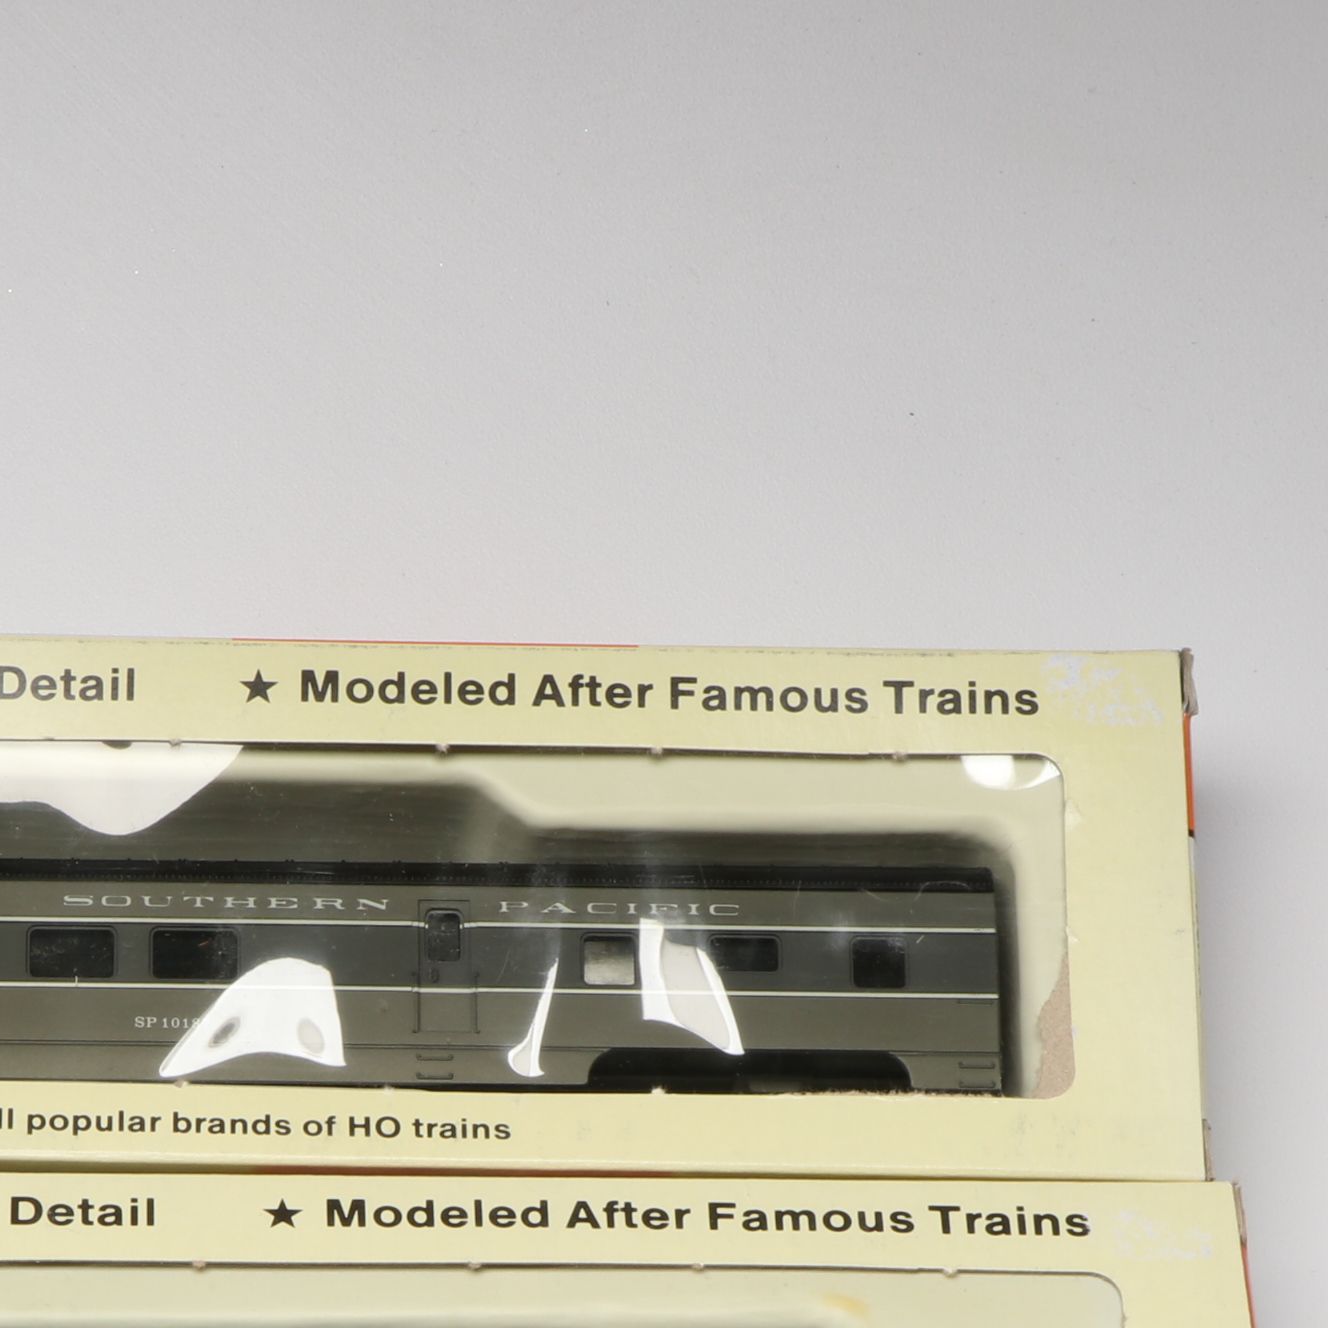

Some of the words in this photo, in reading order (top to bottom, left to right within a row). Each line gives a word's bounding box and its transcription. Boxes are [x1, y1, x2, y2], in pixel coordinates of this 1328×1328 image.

[299, 668, 517, 709] Modeled
[532, 673, 654, 711] After
[670, 676, 870, 715] Famous
[884, 680, 1041, 717] Trains
[62, 894, 390, 912] SOUTHERN
[498, 900, 742, 918] PACIFIC
[134, 1015, 157, 1028] SP
[26, 1106, 161, 1137] popular
[171, 1109, 292, 1137] brands
[301, 1112, 337, 1138] of
[348, 1114, 401, 1139] HO
[411, 1114, 512, 1142] trains
[9, 1195, 158, 1228] Detail
[324, 1197, 550, 1230] Modeled
[566, 1200, 692, 1232] After
[708, 1202, 916, 1235] Famous
[927, 1204, 1092, 1238] Trains
